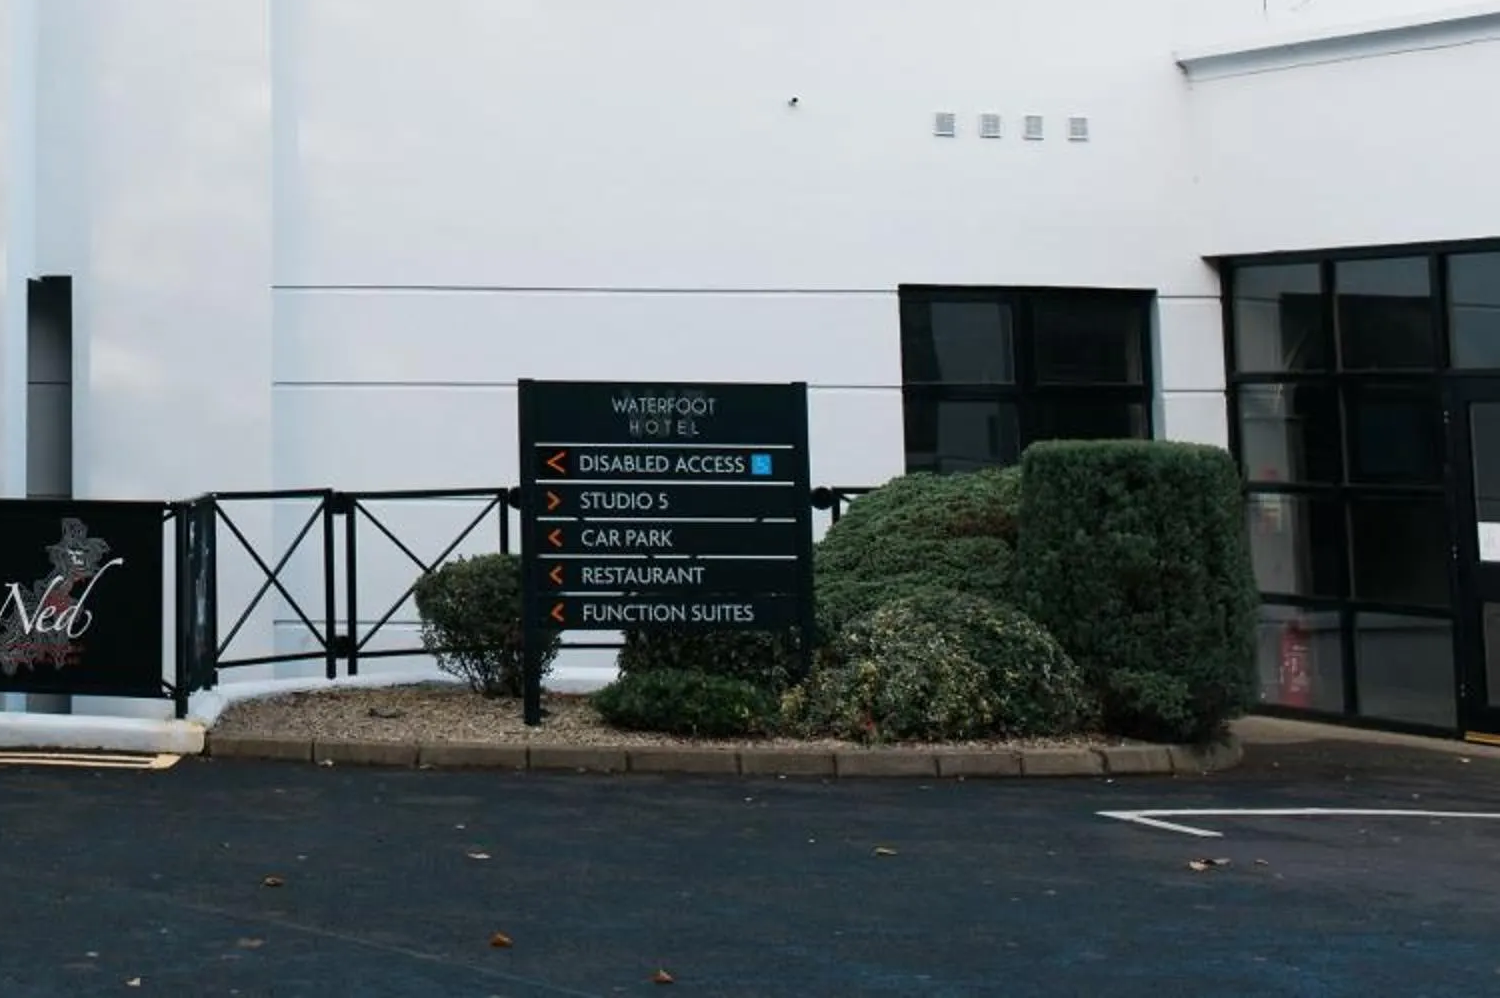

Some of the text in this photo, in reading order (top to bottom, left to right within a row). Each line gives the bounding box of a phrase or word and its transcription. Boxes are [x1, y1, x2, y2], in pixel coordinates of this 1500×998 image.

[611, 397, 716, 416] WATERFOOT
[629, 418, 700, 436] HOTEL
[579, 455, 745, 474] DISABLED ACCESS
[580, 492, 669, 510] STUDIO 5
[581, 529, 673, 547] CAR PARK
[582, 566, 706, 585] RESTAURANT
[583, 604, 755, 622] FUNCTION SUITES
